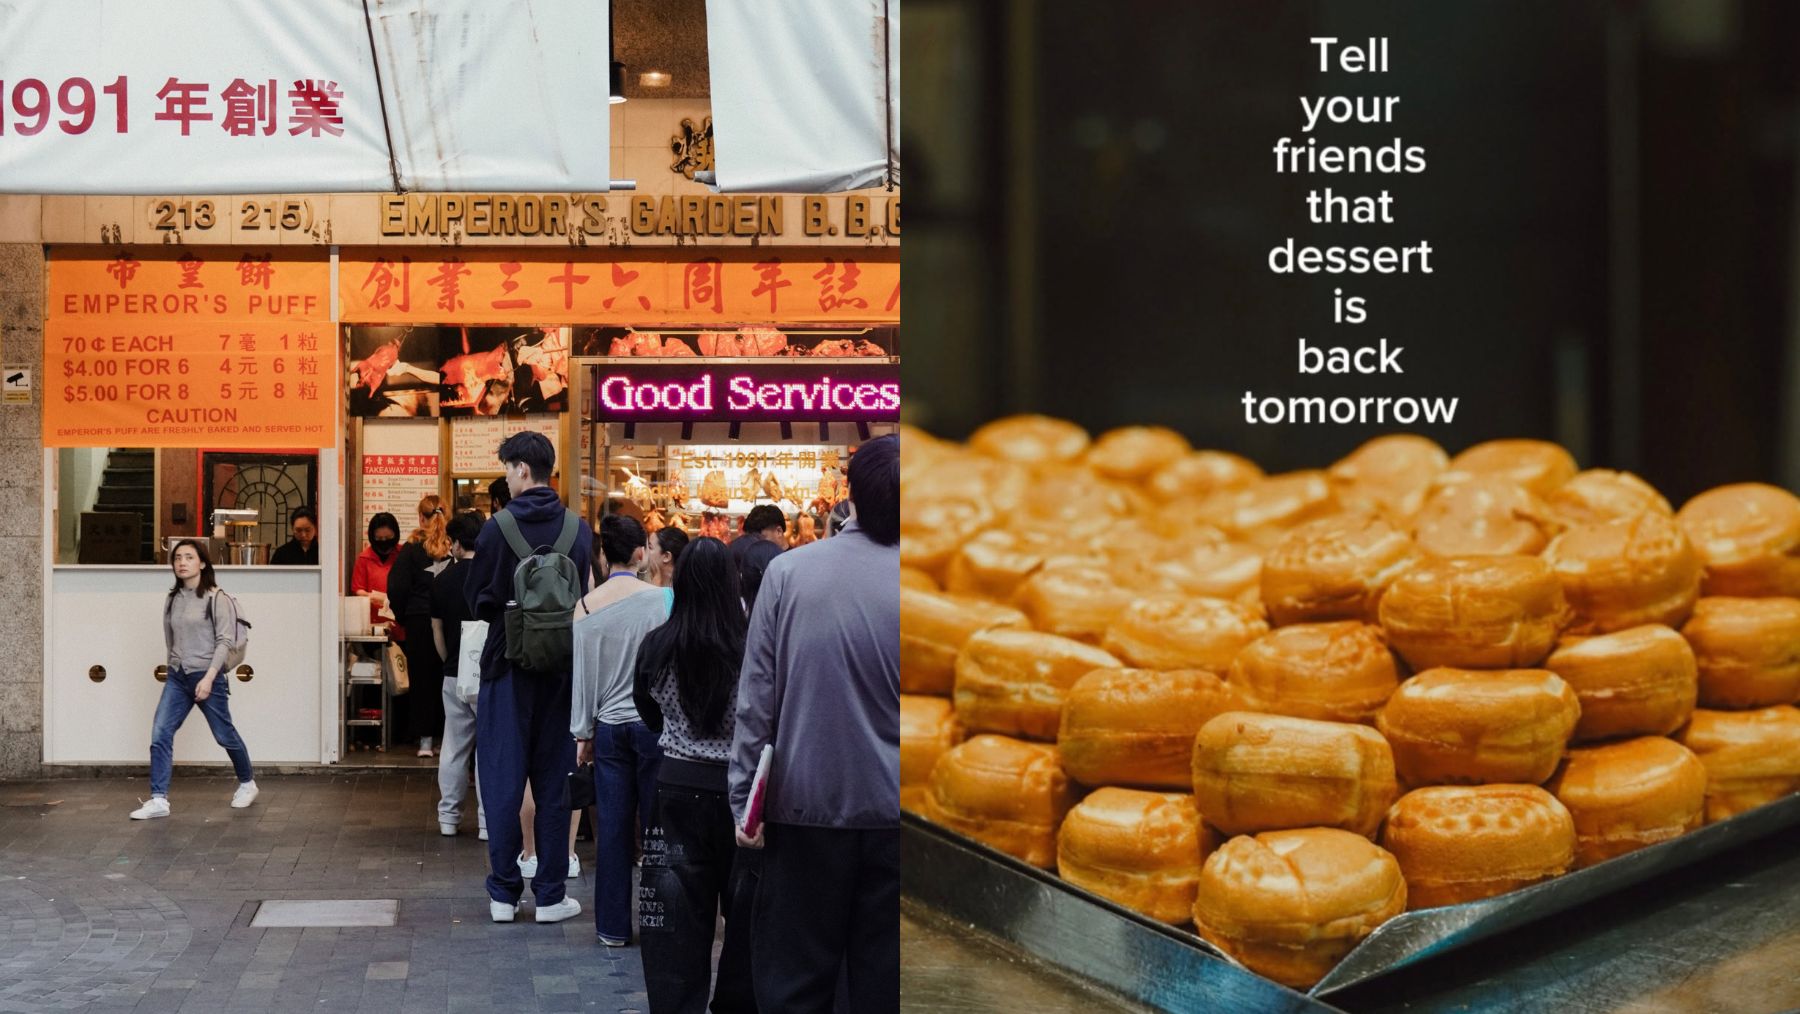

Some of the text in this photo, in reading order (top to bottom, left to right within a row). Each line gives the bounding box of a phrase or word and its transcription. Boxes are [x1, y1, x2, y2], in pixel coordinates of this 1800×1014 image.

[0, 76, 345, 137] 991 年創業
[382, 193, 608, 236] EMPEROR'S
[631, 194, 783, 236] GARDEN
[106, 250, 275, 290] 帝皇餅
[361, 256, 900, 313] 創業三十六周年誌
[64, 294, 317, 315] EMPEROR'S PUFF
[112, 335, 173, 352] EACH
[219, 334, 231, 351] 7
[280, 333, 289, 350] 1
[298, 332, 318, 351] 粒
[63, 356, 318, 377] $4.00 FOR 6 4 元 6 粒
[64, 381, 318, 403] $5.00 FOR 8 5 元 8 粒
[601, 374, 900, 410] Good Services
[147, 408, 237, 423] CAUTION
[57, 428, 112, 436] EMPEROR'S
[115, 427, 137, 435] PUFF
[140, 426, 160, 434] ARE
[163, 425, 203, 434] FRESHLY
[207, 425, 239, 433] BAKED
[242, 425, 261, 433] AND
[265, 425, 301, 433] SERVED
[364, 466, 437, 474] TAKEAWAY PRICES
[682, 451, 717, 469] Est.
[725, 451, 767, 468] 1991
